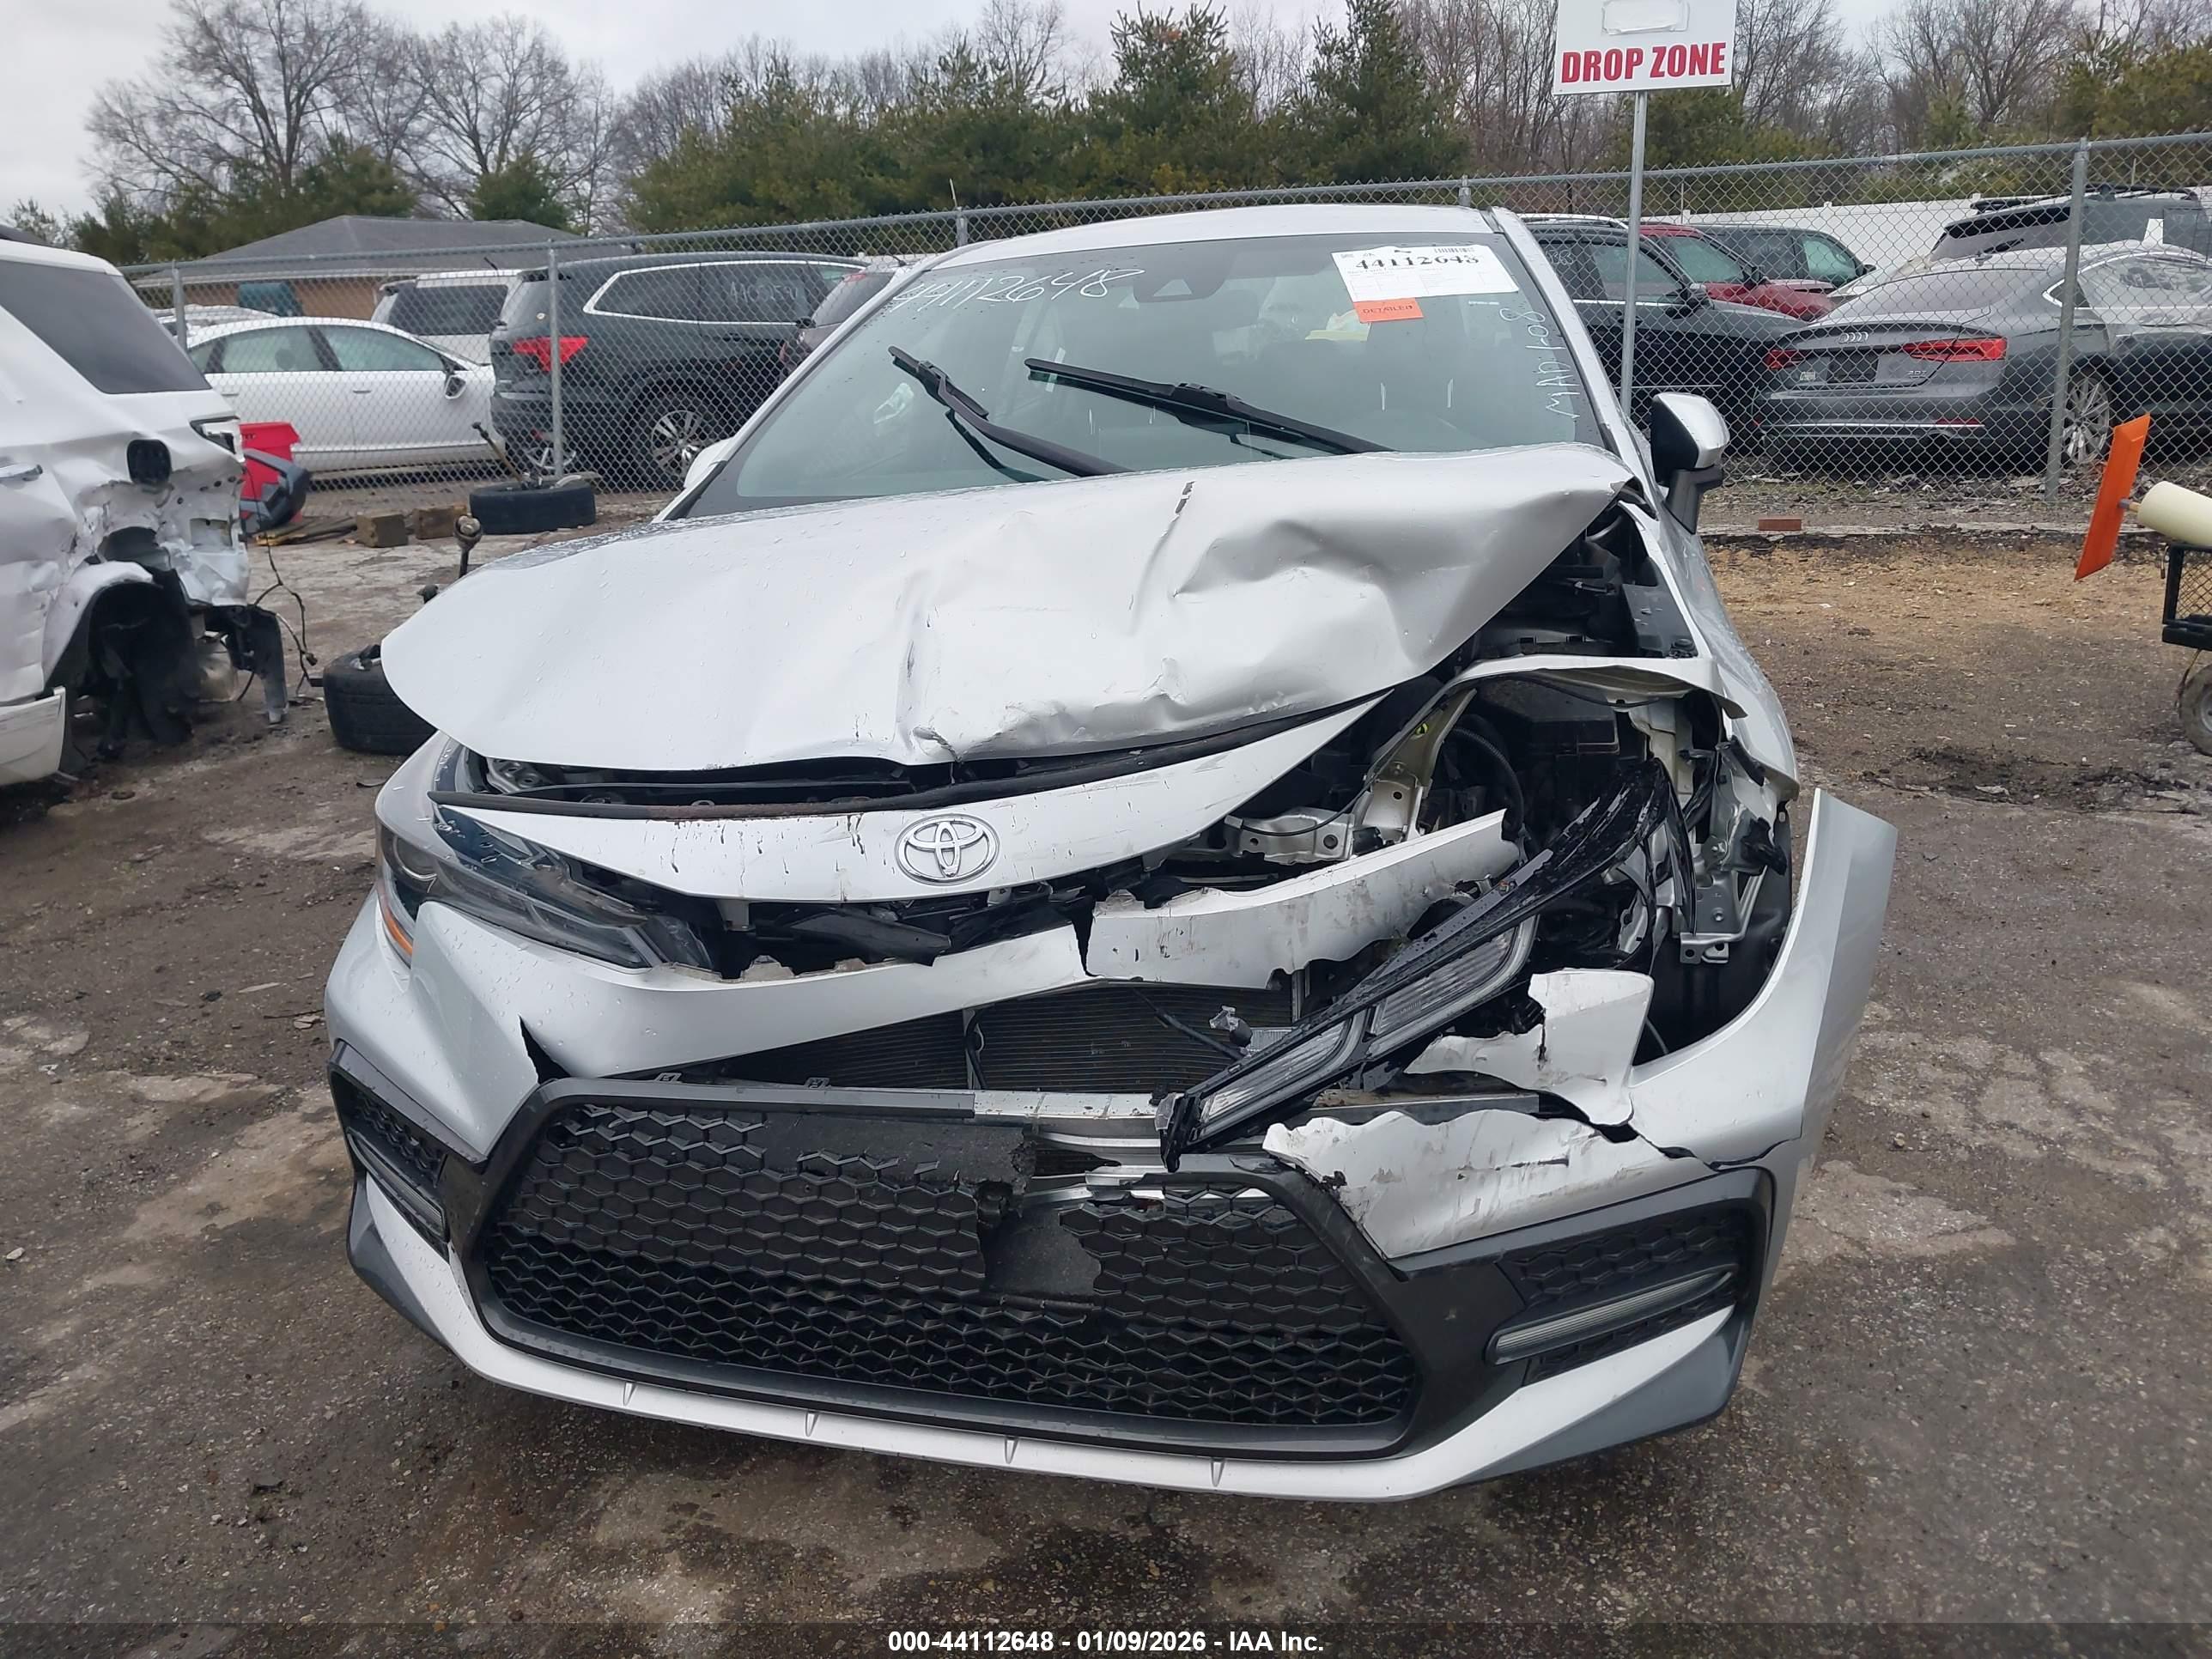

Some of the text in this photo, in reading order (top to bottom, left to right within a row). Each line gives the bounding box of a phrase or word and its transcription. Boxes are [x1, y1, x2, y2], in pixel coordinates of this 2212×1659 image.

[1561, 42, 1726, 83] DROP ZONE
[890, 269, 1146, 313] 44112648
[1362, 304, 1413, 313] DETAILED
[1535, 361, 1581, 419] MAD
